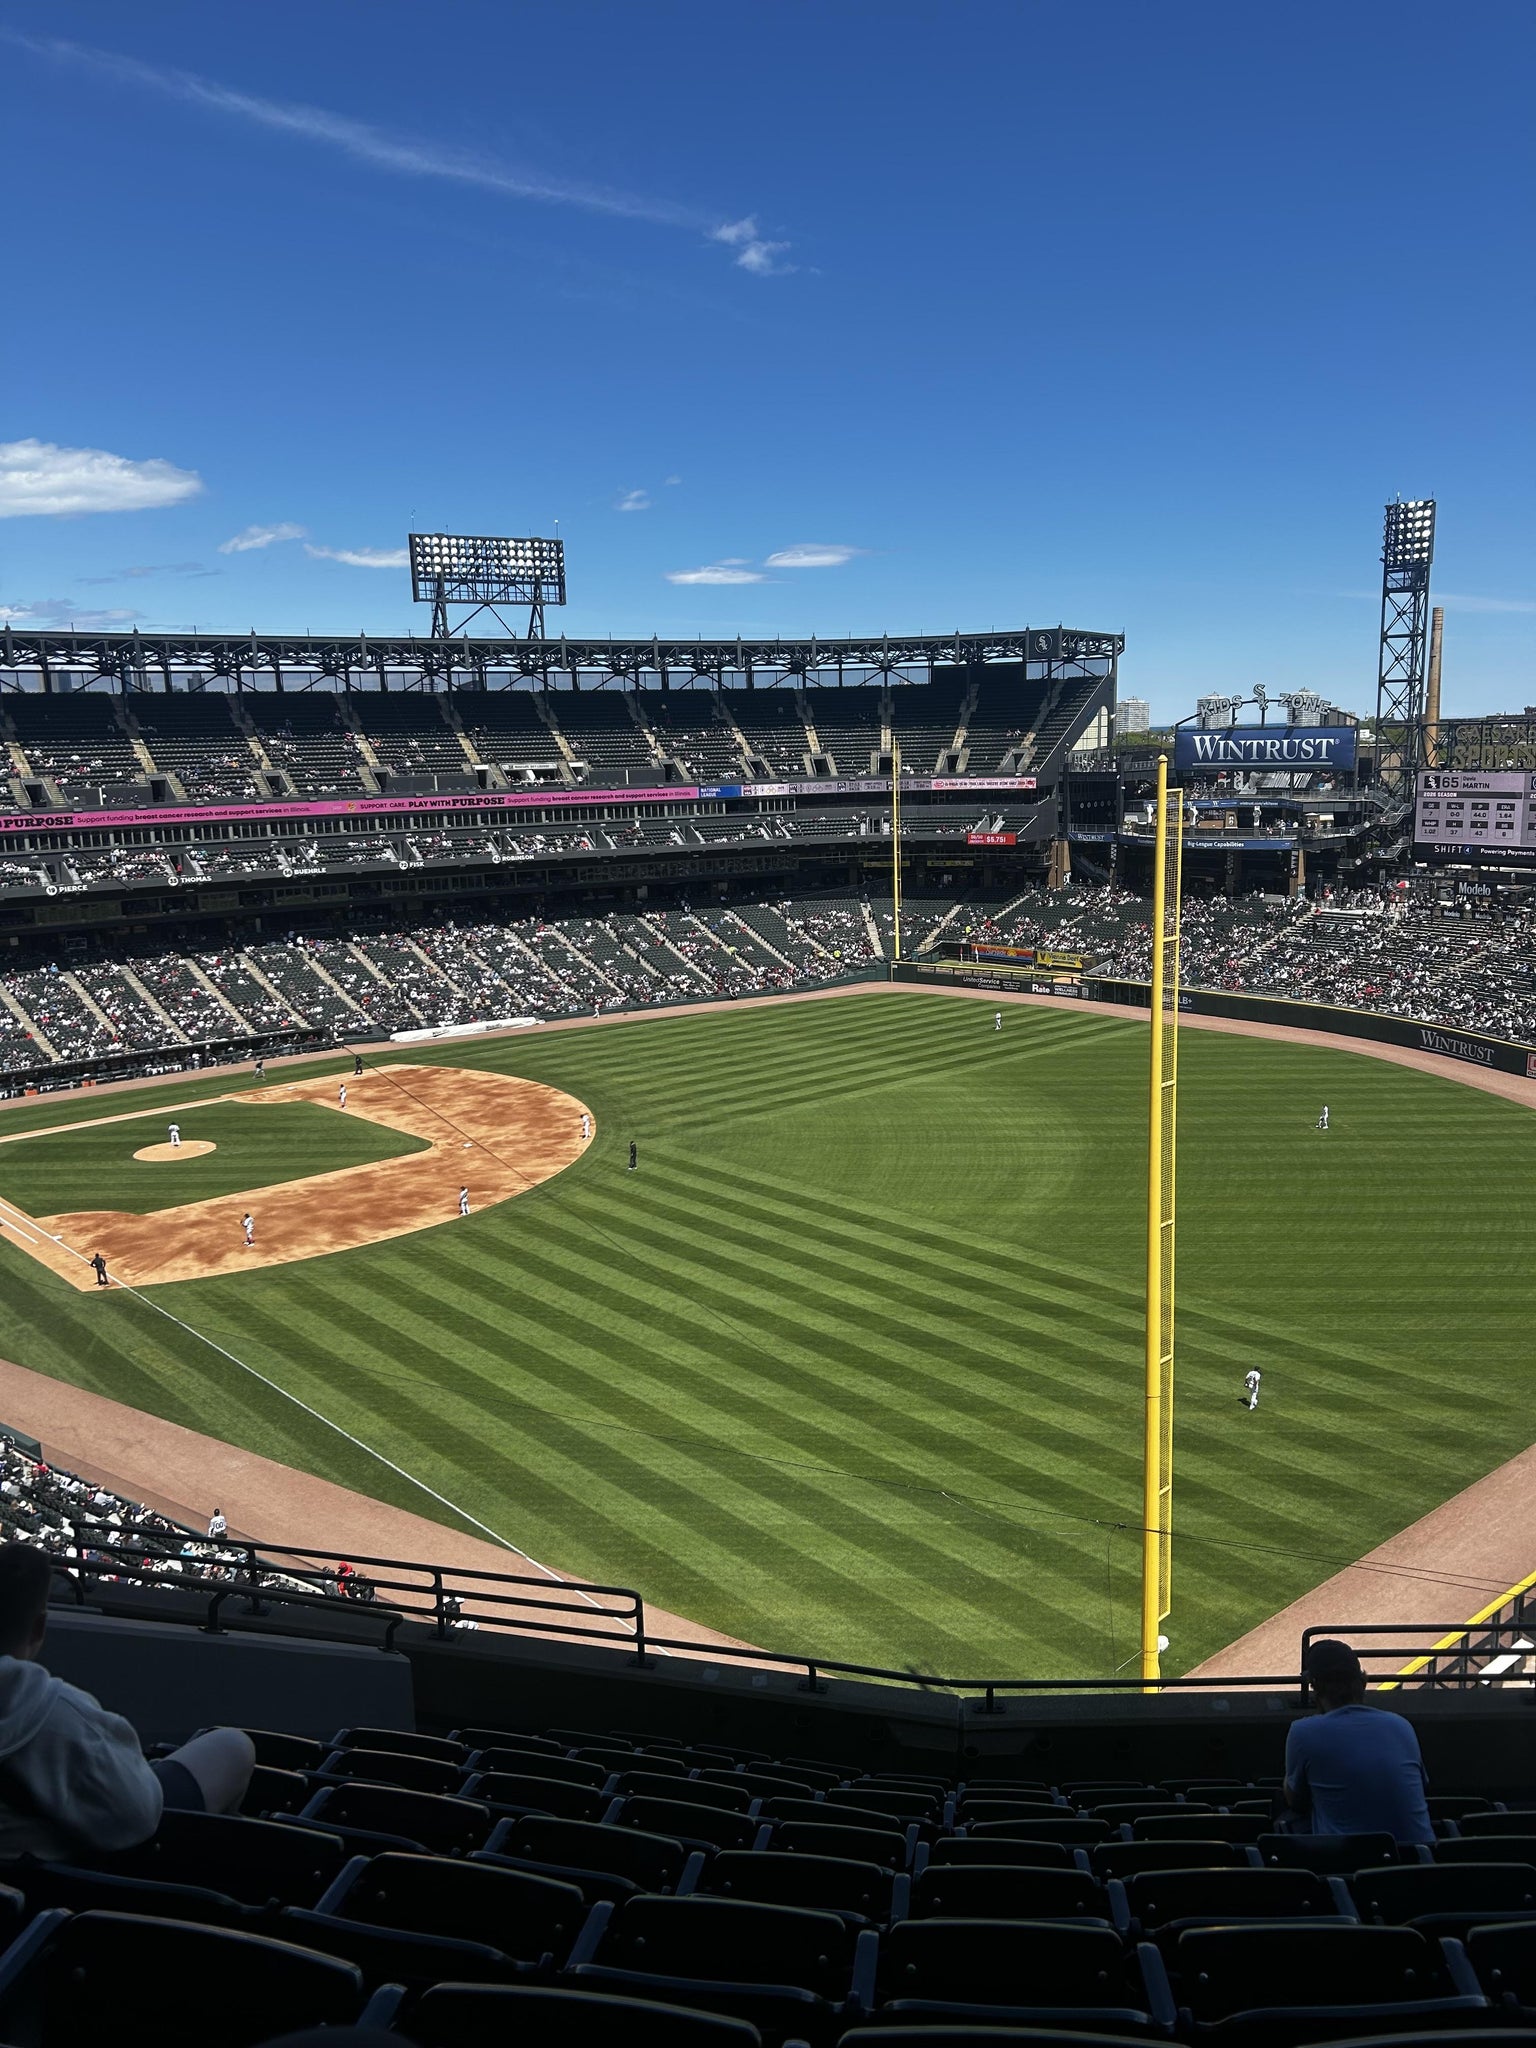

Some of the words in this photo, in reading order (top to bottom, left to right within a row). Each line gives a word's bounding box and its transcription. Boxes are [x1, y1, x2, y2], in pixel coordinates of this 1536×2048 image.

[1199, 694, 1242, 717] KIDS
[1278, 692, 1331, 715] ZONE
[1192, 735, 1335, 760] WINTRUST
[1441, 776, 1459, 788] 65
[451, 797, 505, 806] PURPOSE
[4, 816, 74, 829] PURPOSE
[77, 816, 106, 824] Support
[107, 815, 134, 823] funding
[228, 808, 254, 816] support
[1434, 845, 1462, 853] SHIFT
[1480, 847, 1507, 855] Powering
[1507, 849, 1535, 857] Payments
[294, 867, 326, 875] BUEHRLE
[180, 875, 212, 884] THOMAS
[59, 885, 88, 893] PIERCE
[1458, 882, 1491, 896] Modelo
[1443, 910, 1461, 918] Modelo
[1032, 983, 1050, 993] Rate
[1420, 1029, 1494, 1062] WINTRUST
